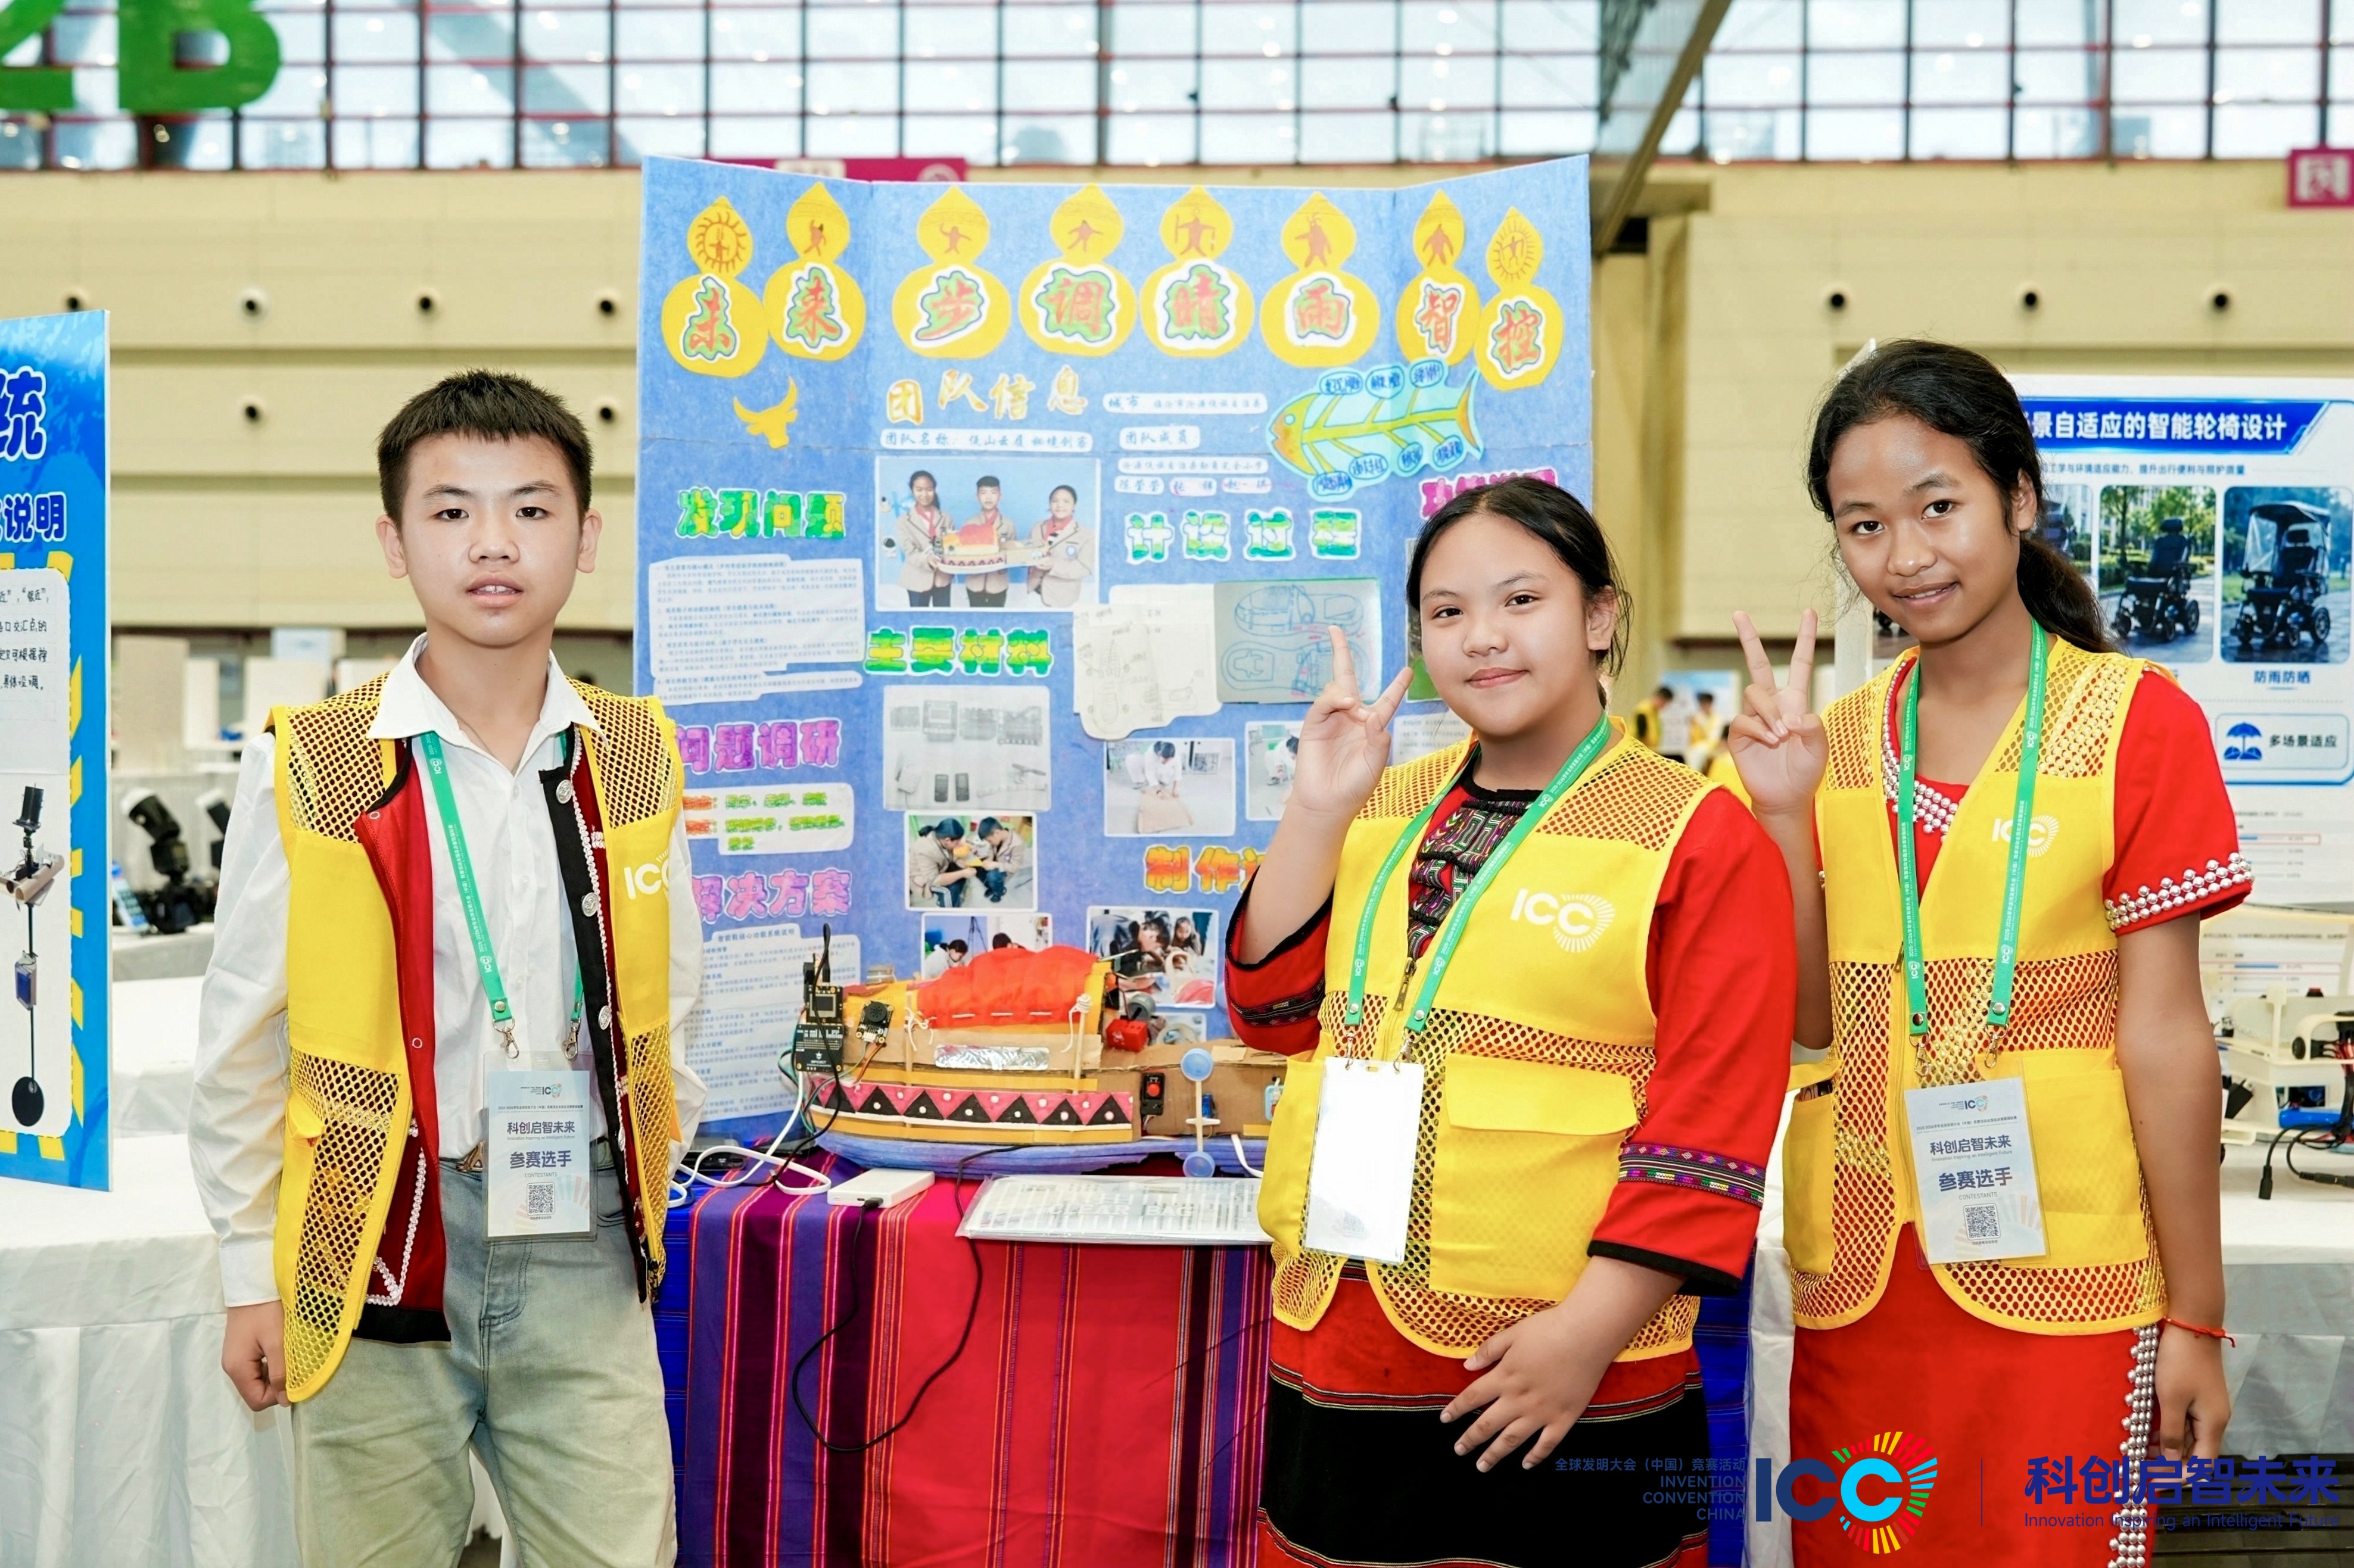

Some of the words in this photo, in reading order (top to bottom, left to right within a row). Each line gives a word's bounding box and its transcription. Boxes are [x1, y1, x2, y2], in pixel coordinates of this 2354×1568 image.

[887, 365, 1088, 425] 团队信息
[2024, 411, 2287, 441] 景自适应的智能轮椅设计
[677, 488, 846, 539] 发现问题
[865, 627, 1053, 675] 主要材料
[2254, 670, 2311, 684] 防雨防晒
[677, 719, 839, 772] 问题调研
[2027, 731, 2037, 749] ICC
[2269, 734, 2337, 748] 多场景适应
[431, 759, 442, 775] ICC
[1539, 794, 1552, 808] ICC
[1511, 889, 1595, 935] ICC
[2001, 945, 2013, 964] ICC
[484, 956, 493, 973] ICC
[1355, 958, 1365, 976] ICC
[1433, 957, 1444, 975] ICC
[1911, 962, 1920, 979] ICC
[506, 1120, 575, 1134] 科创启智未来
[1930, 1134, 2012, 1156] 科创启智未来
[510, 1150, 572, 1170] 参赛选手
[1939, 1167, 2013, 1192] 参赛选手
[1958, 1192, 1998, 1201] CONTESTANTS
[1147, 1204, 1194, 1218] BAG
